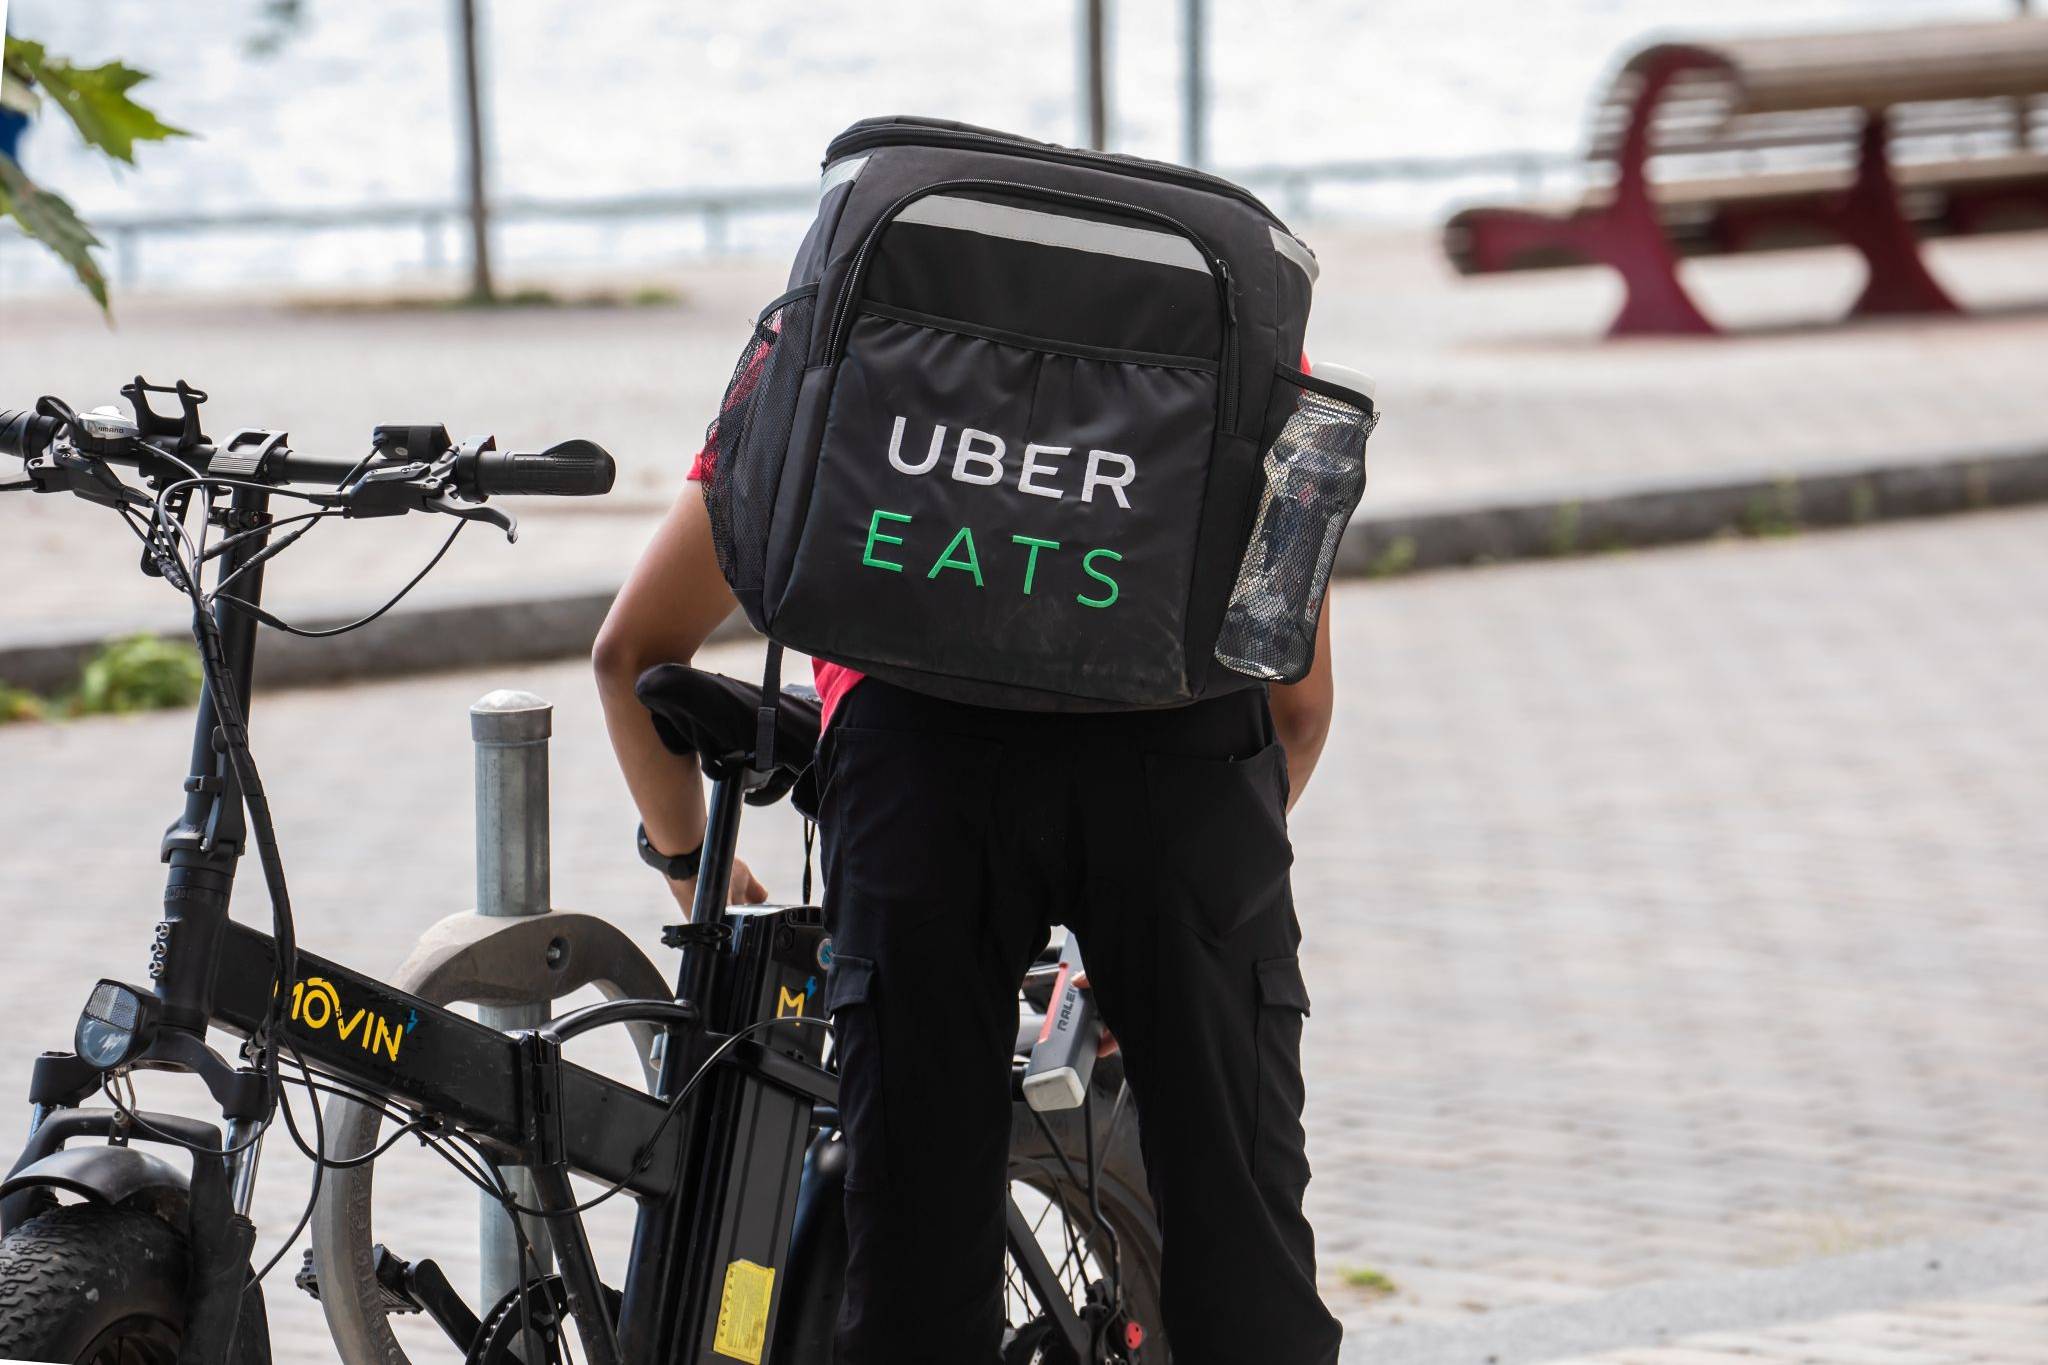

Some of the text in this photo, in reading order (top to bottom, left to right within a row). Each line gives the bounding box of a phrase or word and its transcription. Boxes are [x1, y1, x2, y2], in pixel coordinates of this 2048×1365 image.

[888, 415, 1136, 509] UBER
[862, 509, 1123, 608] EATS
[1057, 985, 1078, 1032] RALEI
